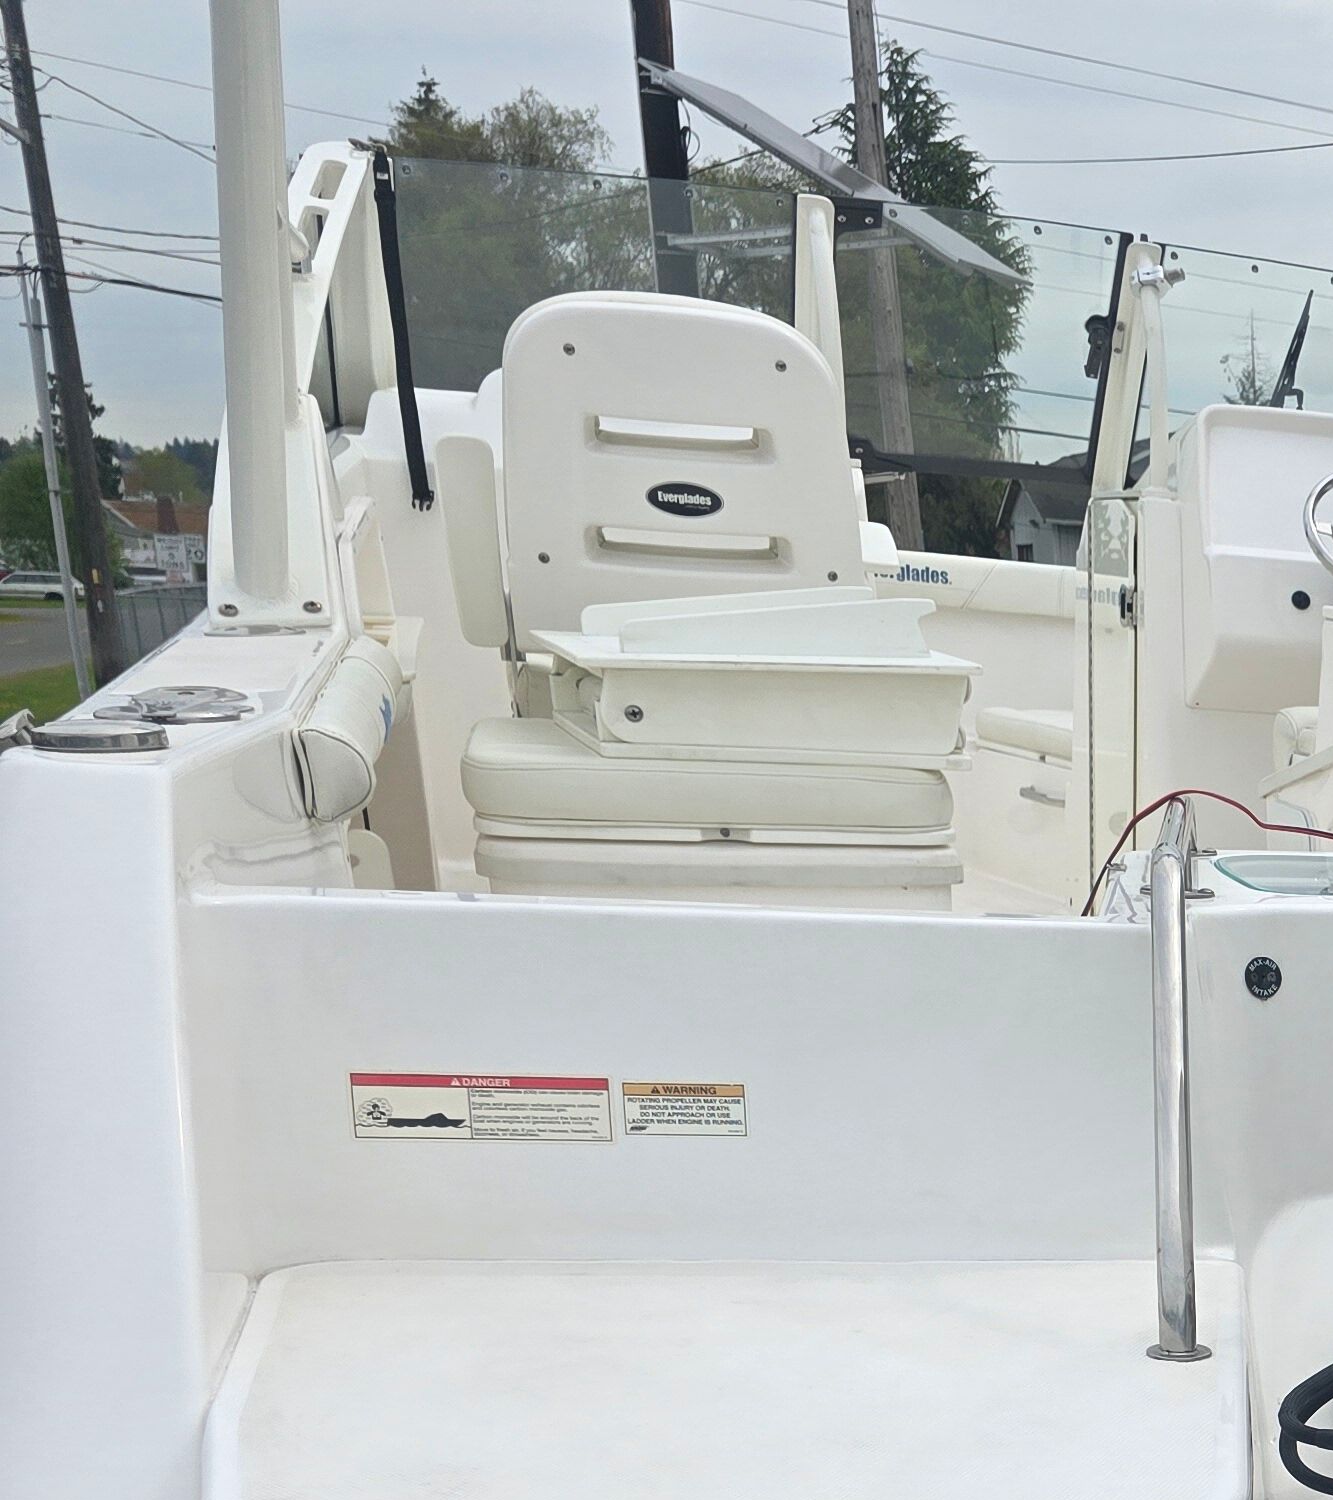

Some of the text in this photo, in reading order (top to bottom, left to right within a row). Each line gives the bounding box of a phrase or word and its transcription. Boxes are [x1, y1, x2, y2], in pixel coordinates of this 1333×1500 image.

[657, 490, 712, 506] Everglades
[1248, 959, 1277, 972] MAX-AIR
[1251, 984, 1278, 997] INTAKE
[462, 1078, 511, 1087] DANGER
[662, 1086, 717, 1095] WARNING
